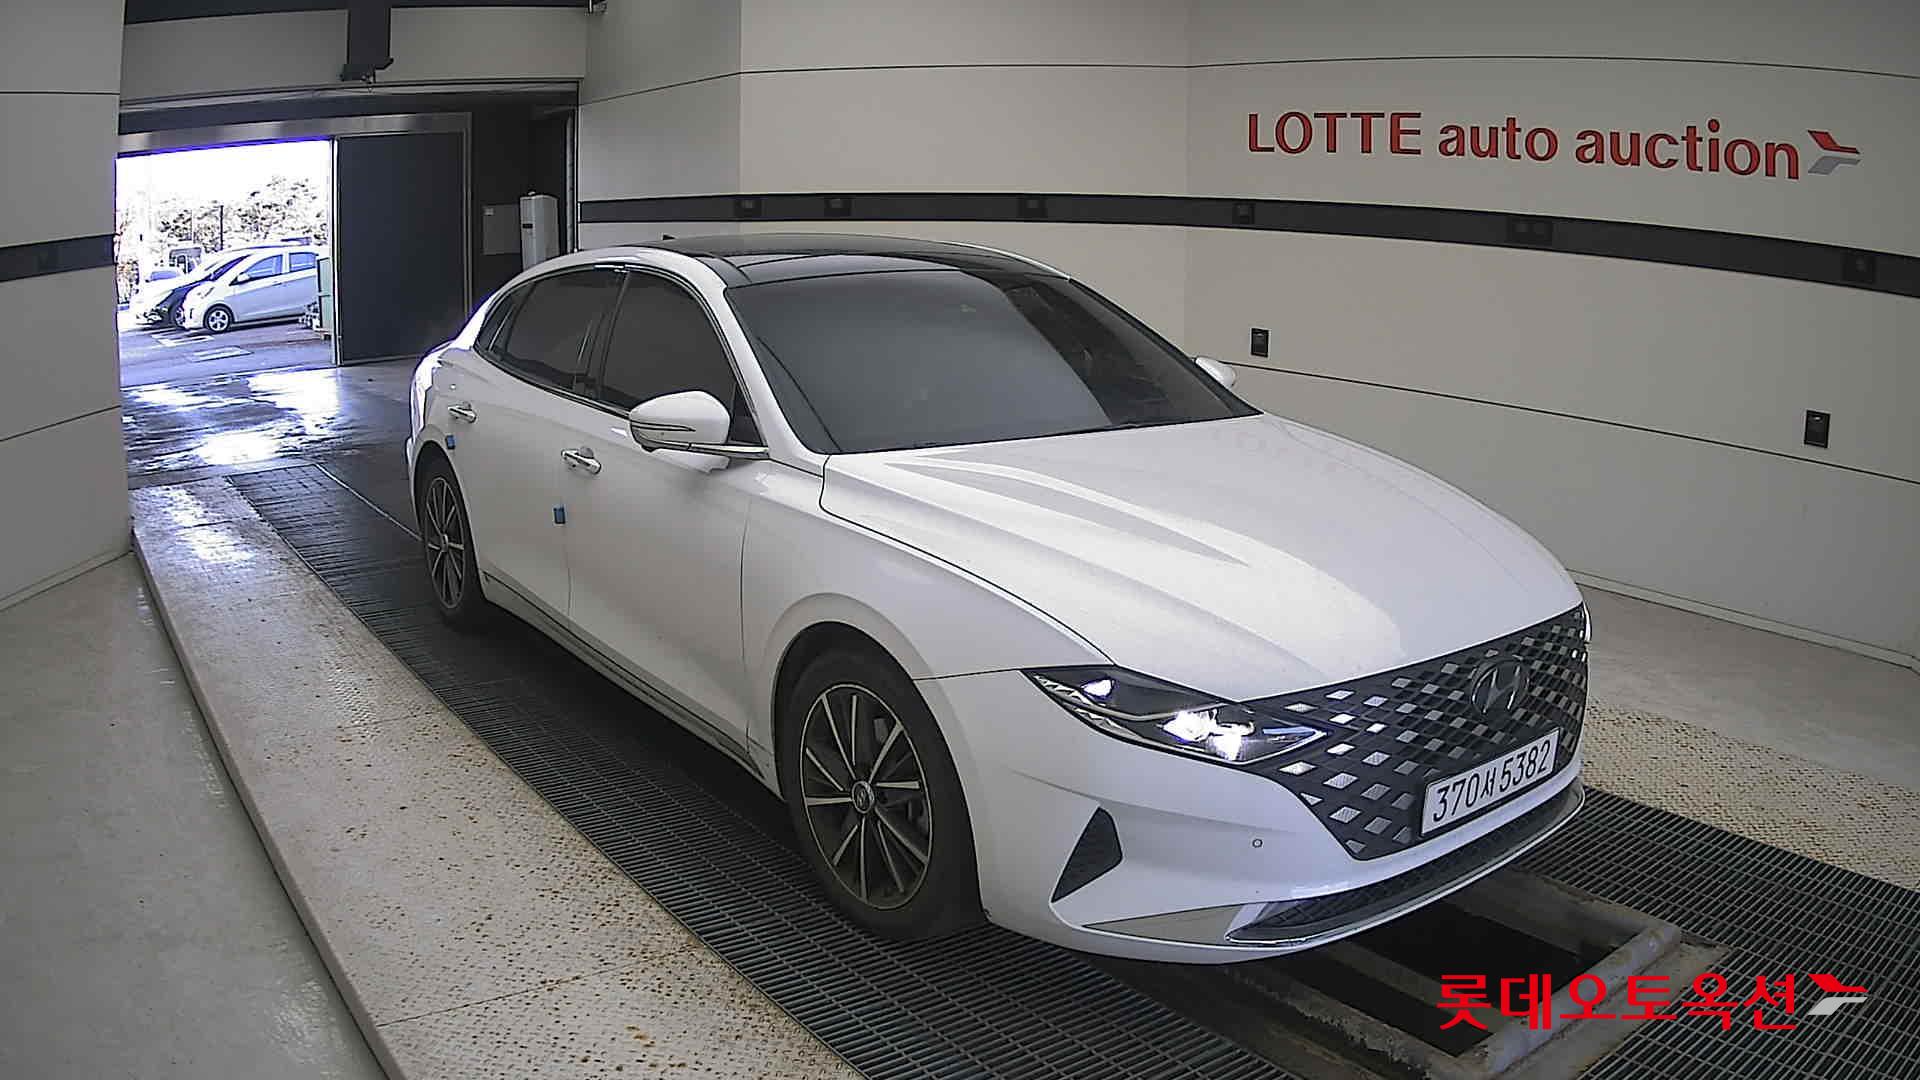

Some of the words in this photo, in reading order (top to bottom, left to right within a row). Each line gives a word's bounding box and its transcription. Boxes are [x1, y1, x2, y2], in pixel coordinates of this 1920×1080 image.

[1248, 112, 1422, 155] LOTTE
[1438, 116, 1559, 162] auto
[1575, 119, 1800, 180] auction
